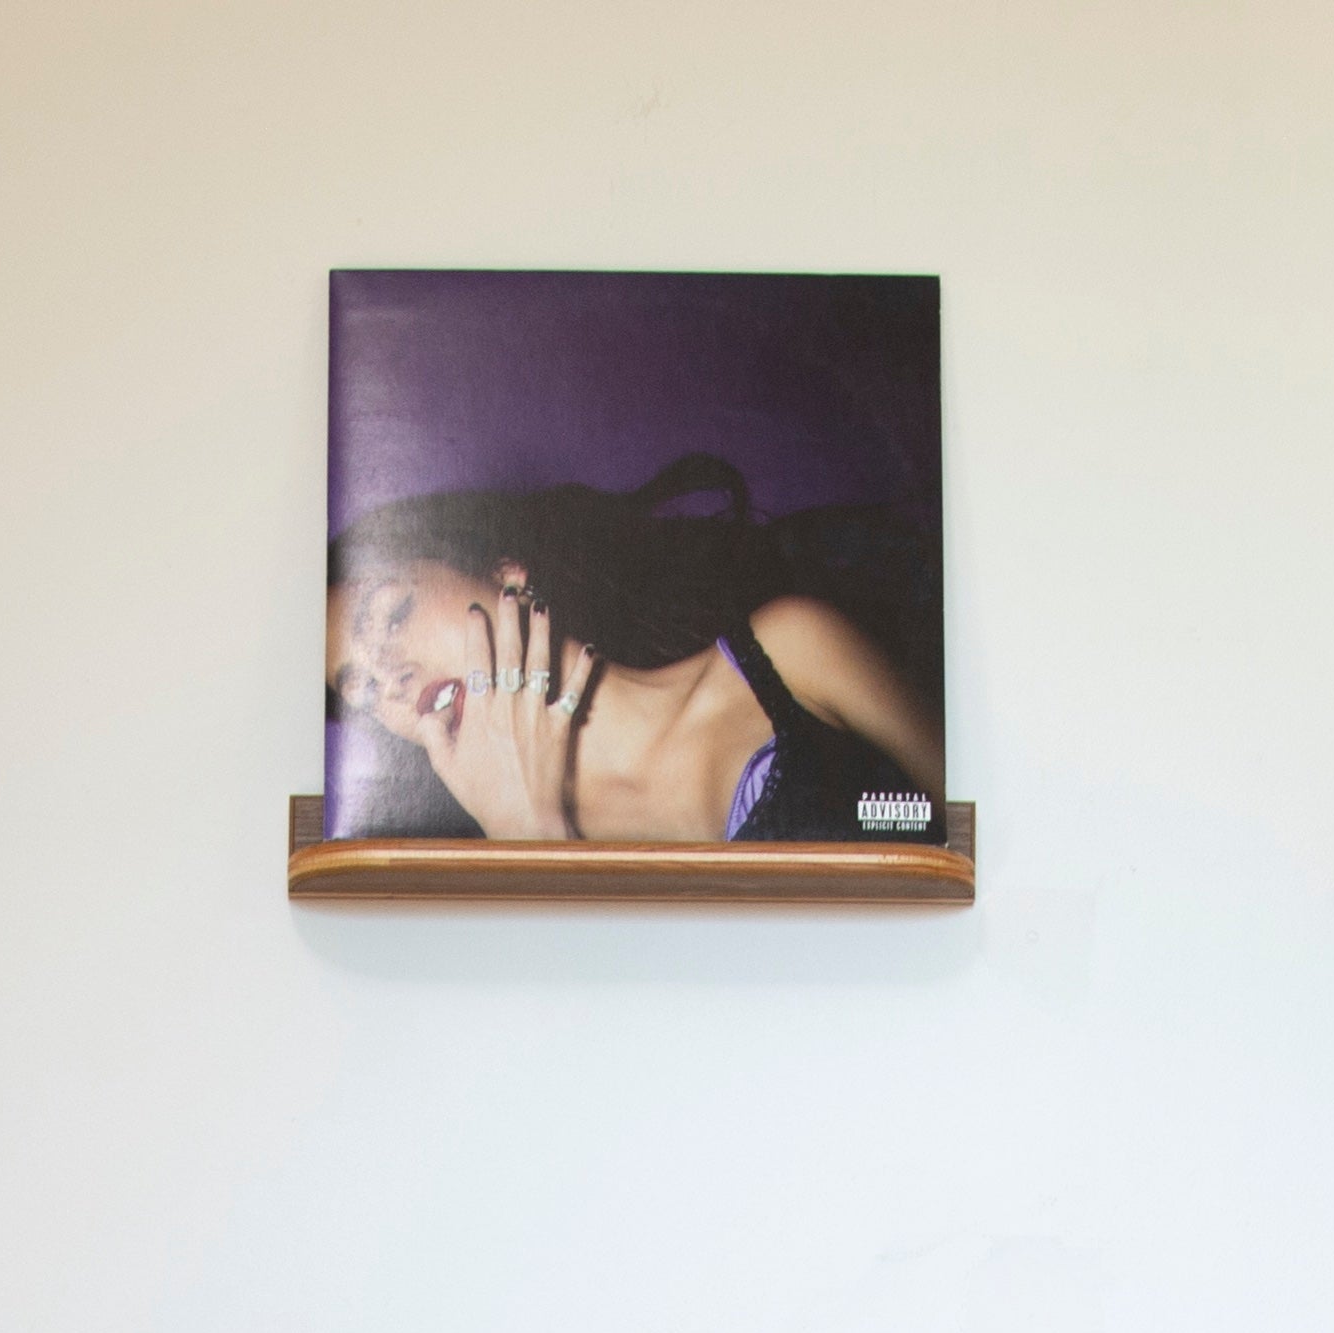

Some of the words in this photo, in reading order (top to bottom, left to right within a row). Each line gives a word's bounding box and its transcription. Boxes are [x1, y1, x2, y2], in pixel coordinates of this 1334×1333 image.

[861, 791, 927, 802] PARENTAL
[860, 803, 927, 819] ADVISORY
[862, 821, 894, 831] EXPLICIT
[896, 821, 927, 832] CONTENT
